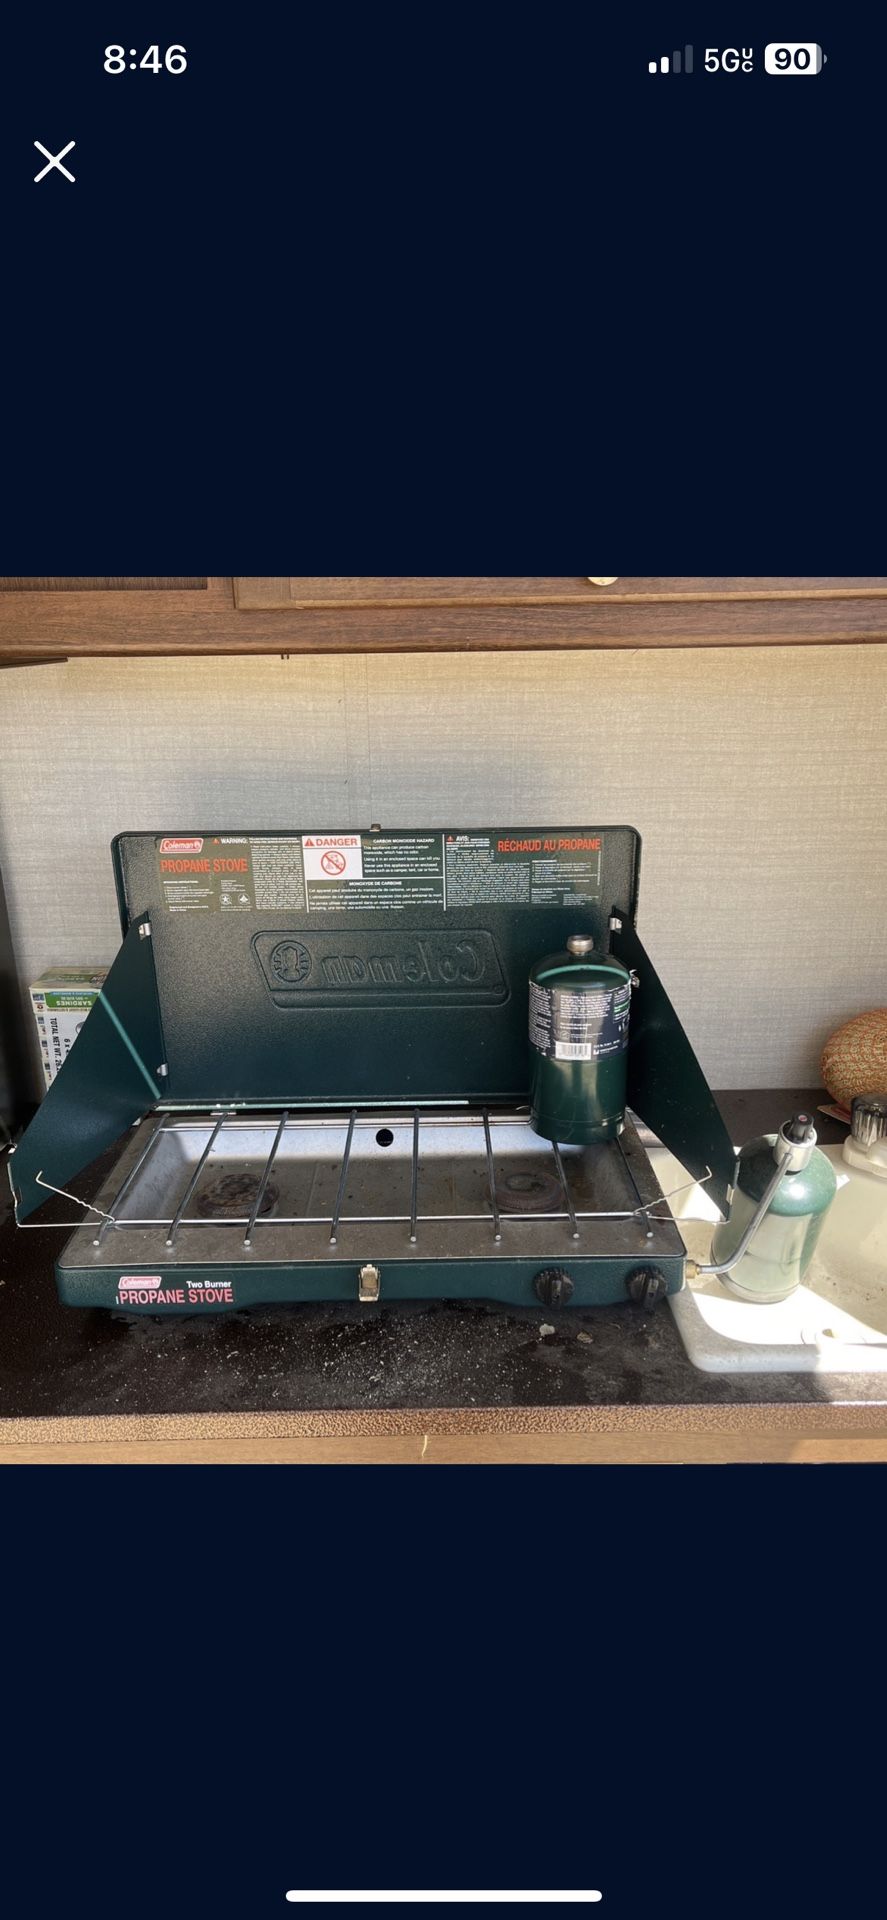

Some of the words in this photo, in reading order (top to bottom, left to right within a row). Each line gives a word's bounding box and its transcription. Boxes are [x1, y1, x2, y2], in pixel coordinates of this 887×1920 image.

[163, 840, 194, 851] Coleman
[316, 838, 358, 846] DANGER
[498, 837, 542, 852] RÉCHAUD
[543, 840, 556, 851] AU
[558, 838, 601, 850] PROPANE
[161, 859, 210, 873] PROPANE
[213, 858, 248, 872] STOVE
[50, 1018, 58, 1035] TOTAL
[204, 1280, 231, 1288] Burner
[119, 1289, 185, 1305] PROPANE
[188, 1288, 234, 1304] STOVE
